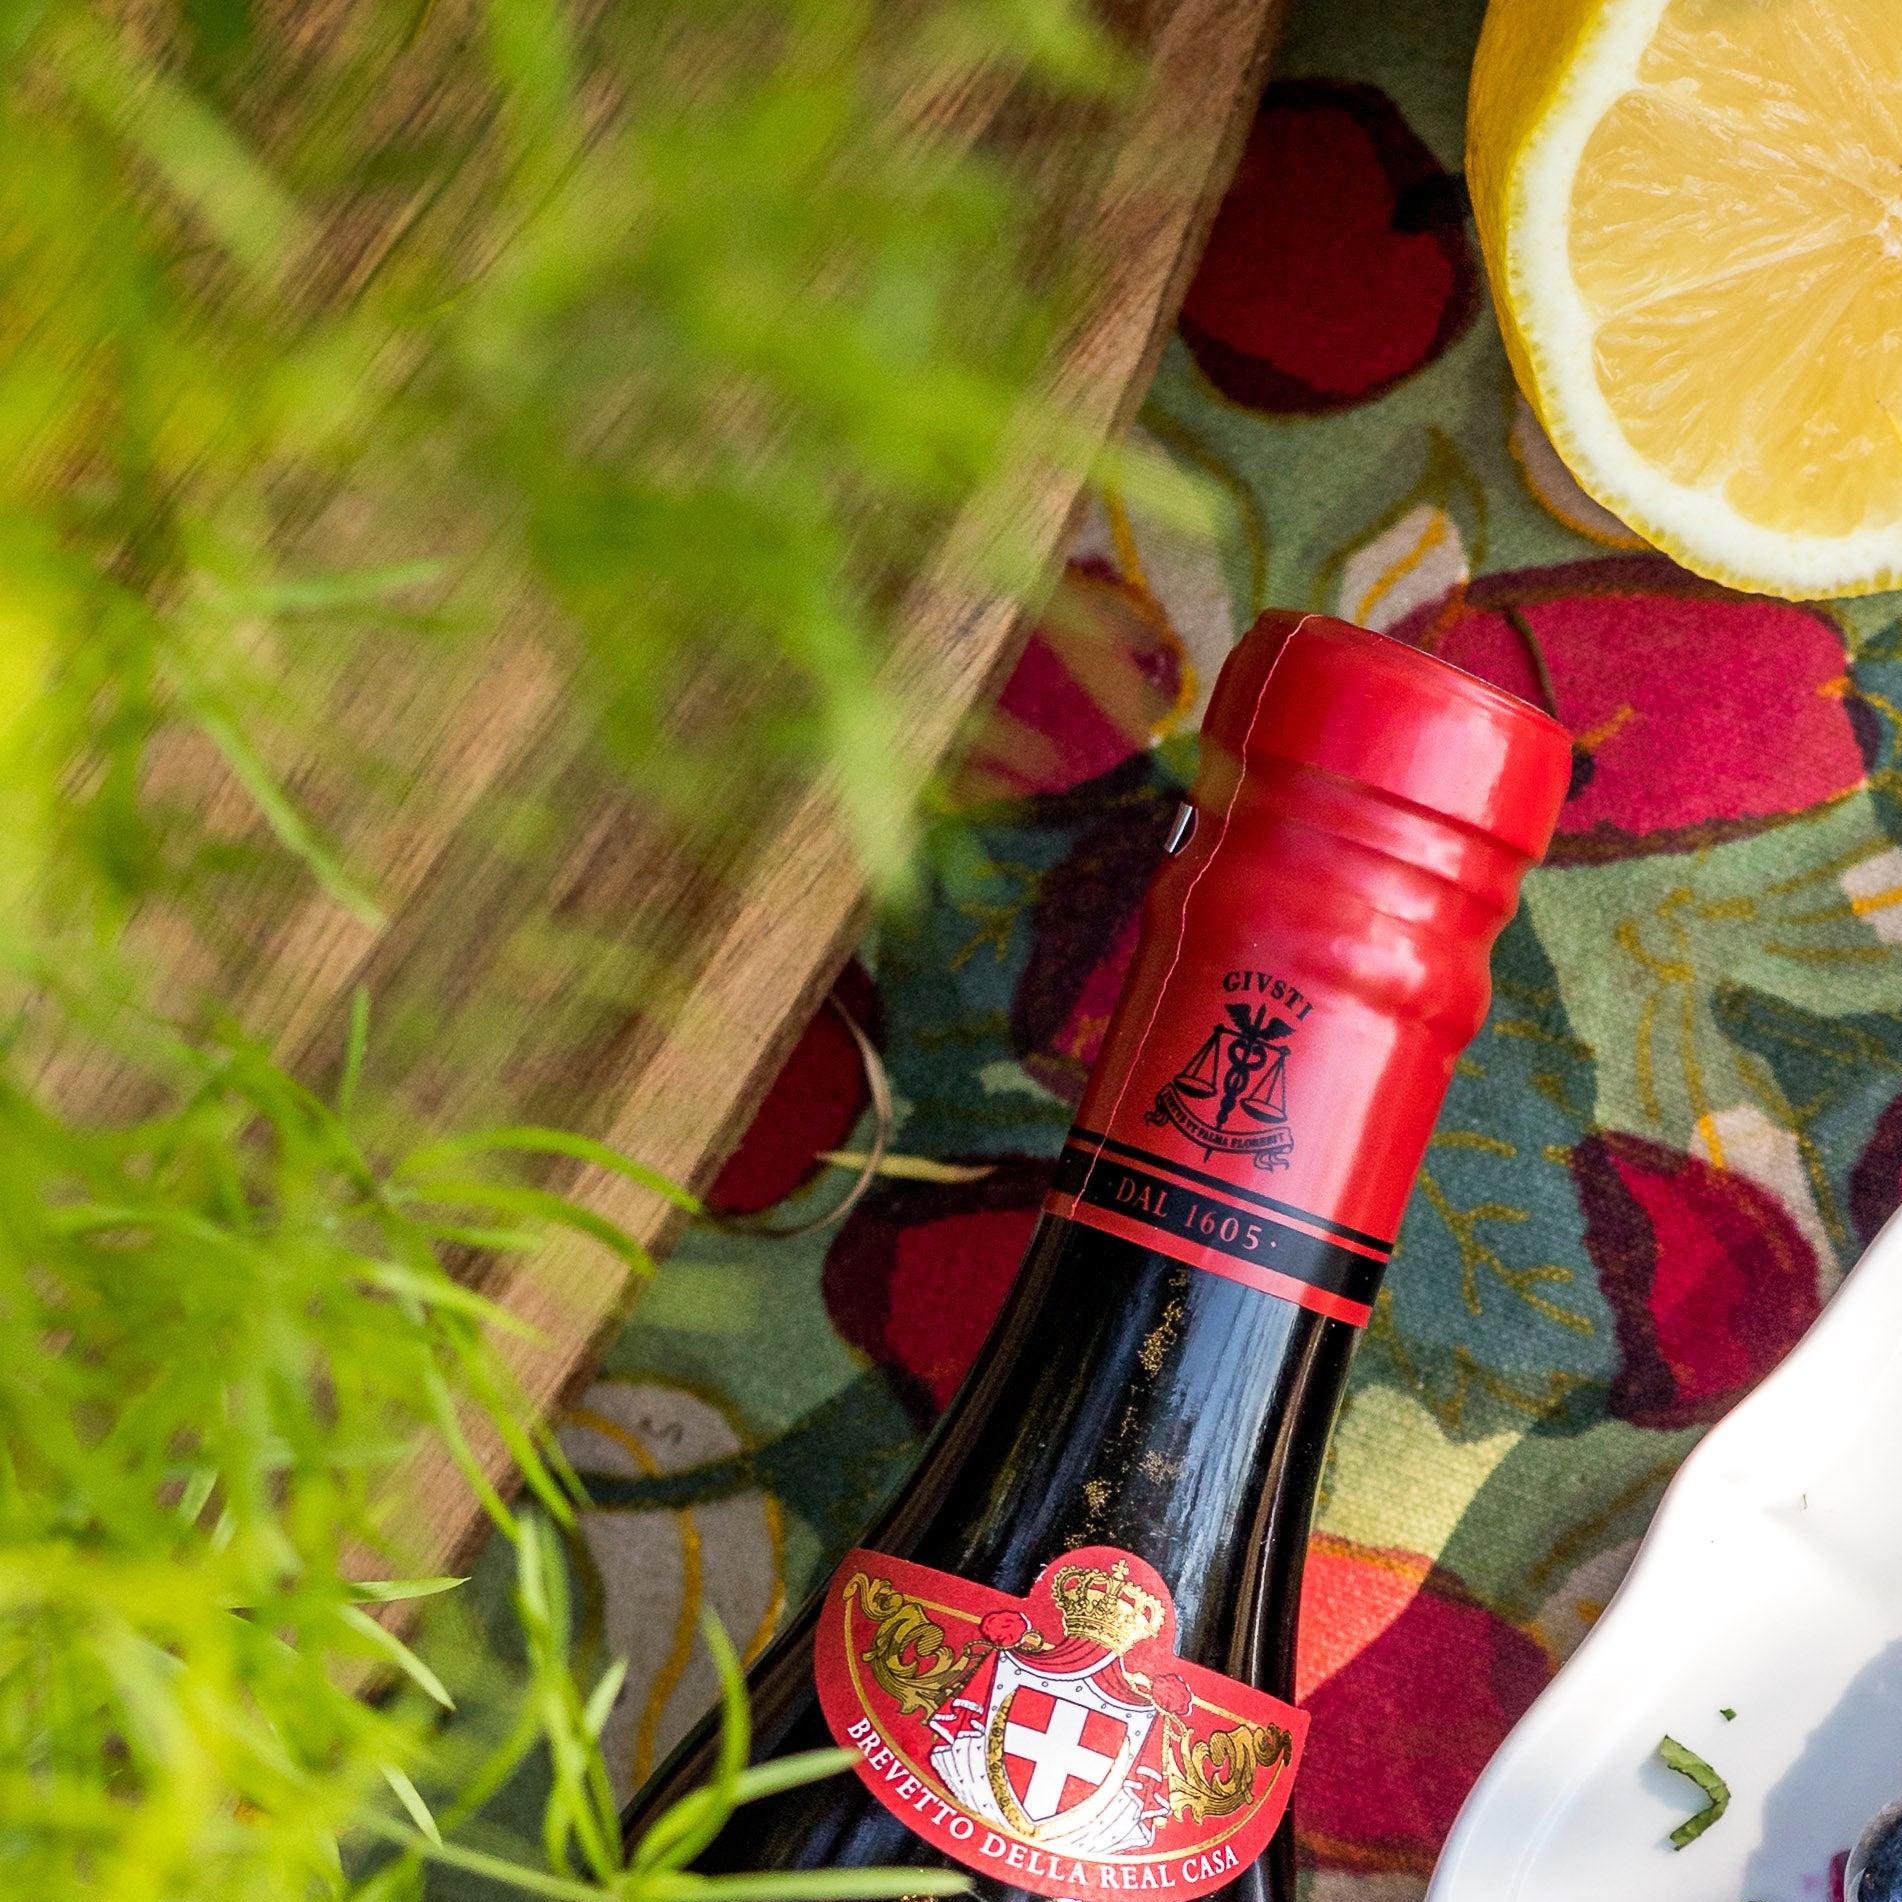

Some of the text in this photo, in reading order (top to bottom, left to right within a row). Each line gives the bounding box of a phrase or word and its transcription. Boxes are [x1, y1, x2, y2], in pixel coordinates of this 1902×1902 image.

[1223, 970, 1313, 1021] GIVSTI
[1115, 1176, 1262, 1251] DAL 1605
[847, 1717, 1240, 1890] BREVETTO DELLA REAL CASA
